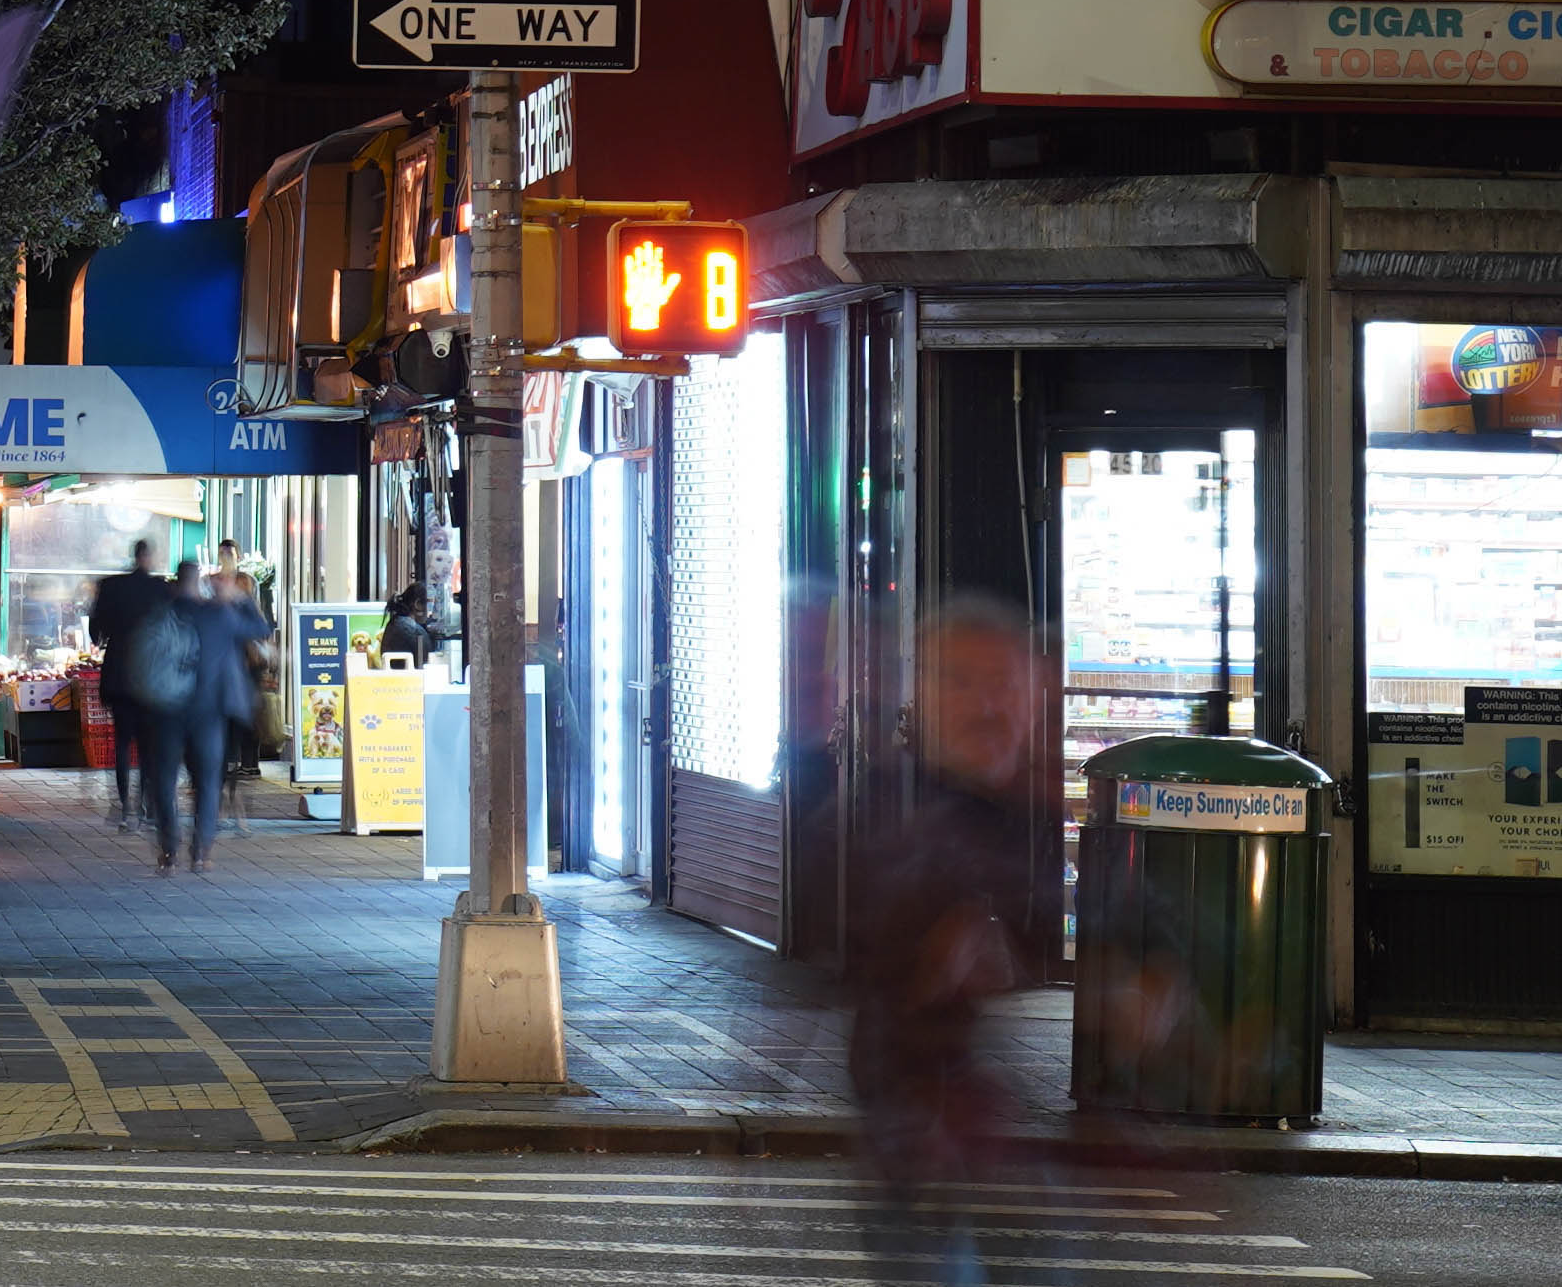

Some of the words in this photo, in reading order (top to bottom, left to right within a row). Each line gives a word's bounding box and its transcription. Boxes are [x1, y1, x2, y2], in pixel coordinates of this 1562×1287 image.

[399, 6, 476, 42] ONE
[516, 9, 601, 43] WAY
[1328, 6, 1463, 38] CIGAR
[1508, 9, 1562, 40] CI
[1269, 54, 1290, 77] &
[1313, 48, 1530, 81] TOBACCO
[705, 249, 738, 329] 8
[1497, 328, 1528, 344] NEW
[1499, 343, 1537, 363] YORK
[1460, 361, 1540, 390] LOTTERY
[229, 421, 287, 451] ATM
[32, 449, 66, 463] 1864
[1482, 689, 1537, 700] WARNING:
[1539, 690, 1560, 701] This
[1476, 701, 1519, 711] contains
[1521, 702, 1562, 712] nicotine.
[1383, 714, 1425, 724] WARNING:
[1427, 715, 1445, 724] This
[1482, 712, 1490, 720] is
[1492, 713, 1506, 721] an
[1508, 712, 1552, 723] addictive
[1379, 725, 1413, 733] contains
[1404, 734, 1441, 742] addictive
[1426, 785, 1444, 793] THE
[1156, 788, 1193, 818] Keep
[1196, 791, 1270, 820] Sunnyside
[1273, 793, 1303, 816] Clean
[1426, 797, 1463, 806] SWITCH
[1488, 814, 1518, 824] YOUR
[1522, 815, 1561, 825] EXPERI
[1500, 826, 1530, 836] YOUR
[1426, 835, 1443, 844] $15
